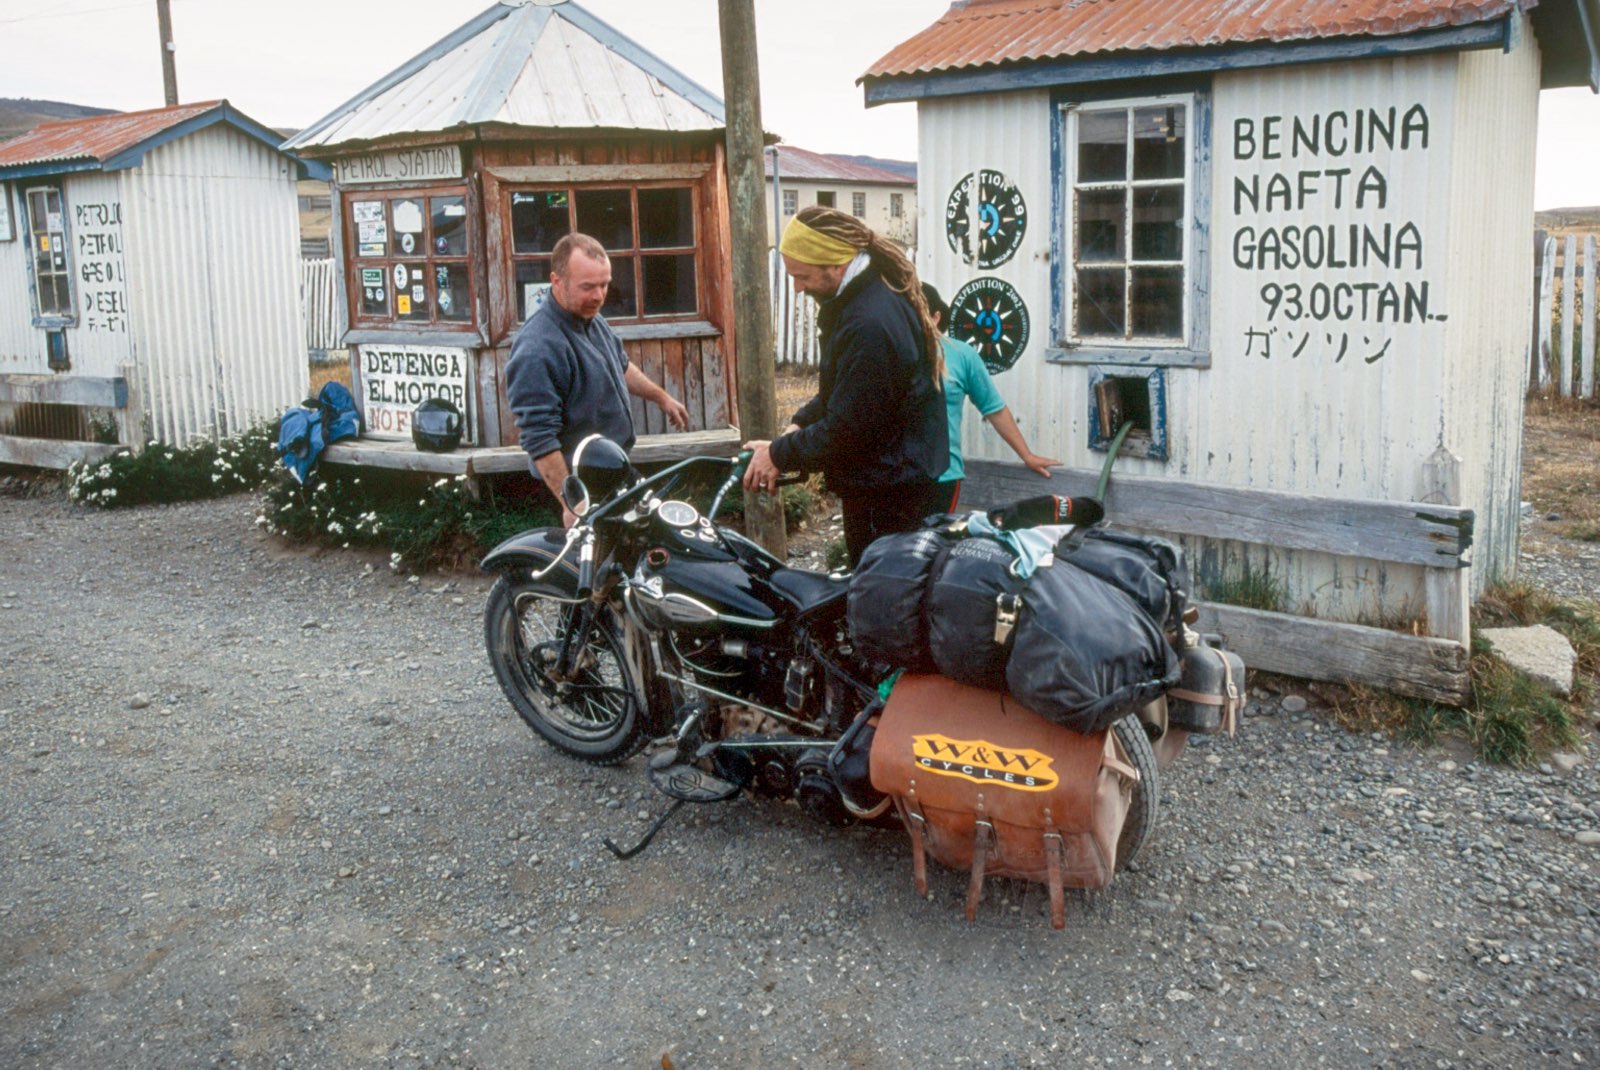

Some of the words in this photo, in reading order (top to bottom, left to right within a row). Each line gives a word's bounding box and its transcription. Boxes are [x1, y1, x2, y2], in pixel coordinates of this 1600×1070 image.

[1233, 103, 1429, 160] BENCINA
[339, 150, 392, 181] PETROL
[397, 147, 457, 177] STATION
[1233, 165, 1388, 215] NAFTA
[1233, 221, 1423, 270] GASOLINA
[81, 261, 123, 283] GASOL
[954, 279, 1005, 308] EXPEDITION
[1243, 326, 1392, 364] ガソリン
[365, 351, 462, 378] DETENGA
[368, 379, 392, 402] EL
[393, 381, 463, 408] MOTOR
[370, 407, 392, 431] NO
[925, 739, 1040, 771] W&W
[920, 758, 1035, 786] CYCLES
